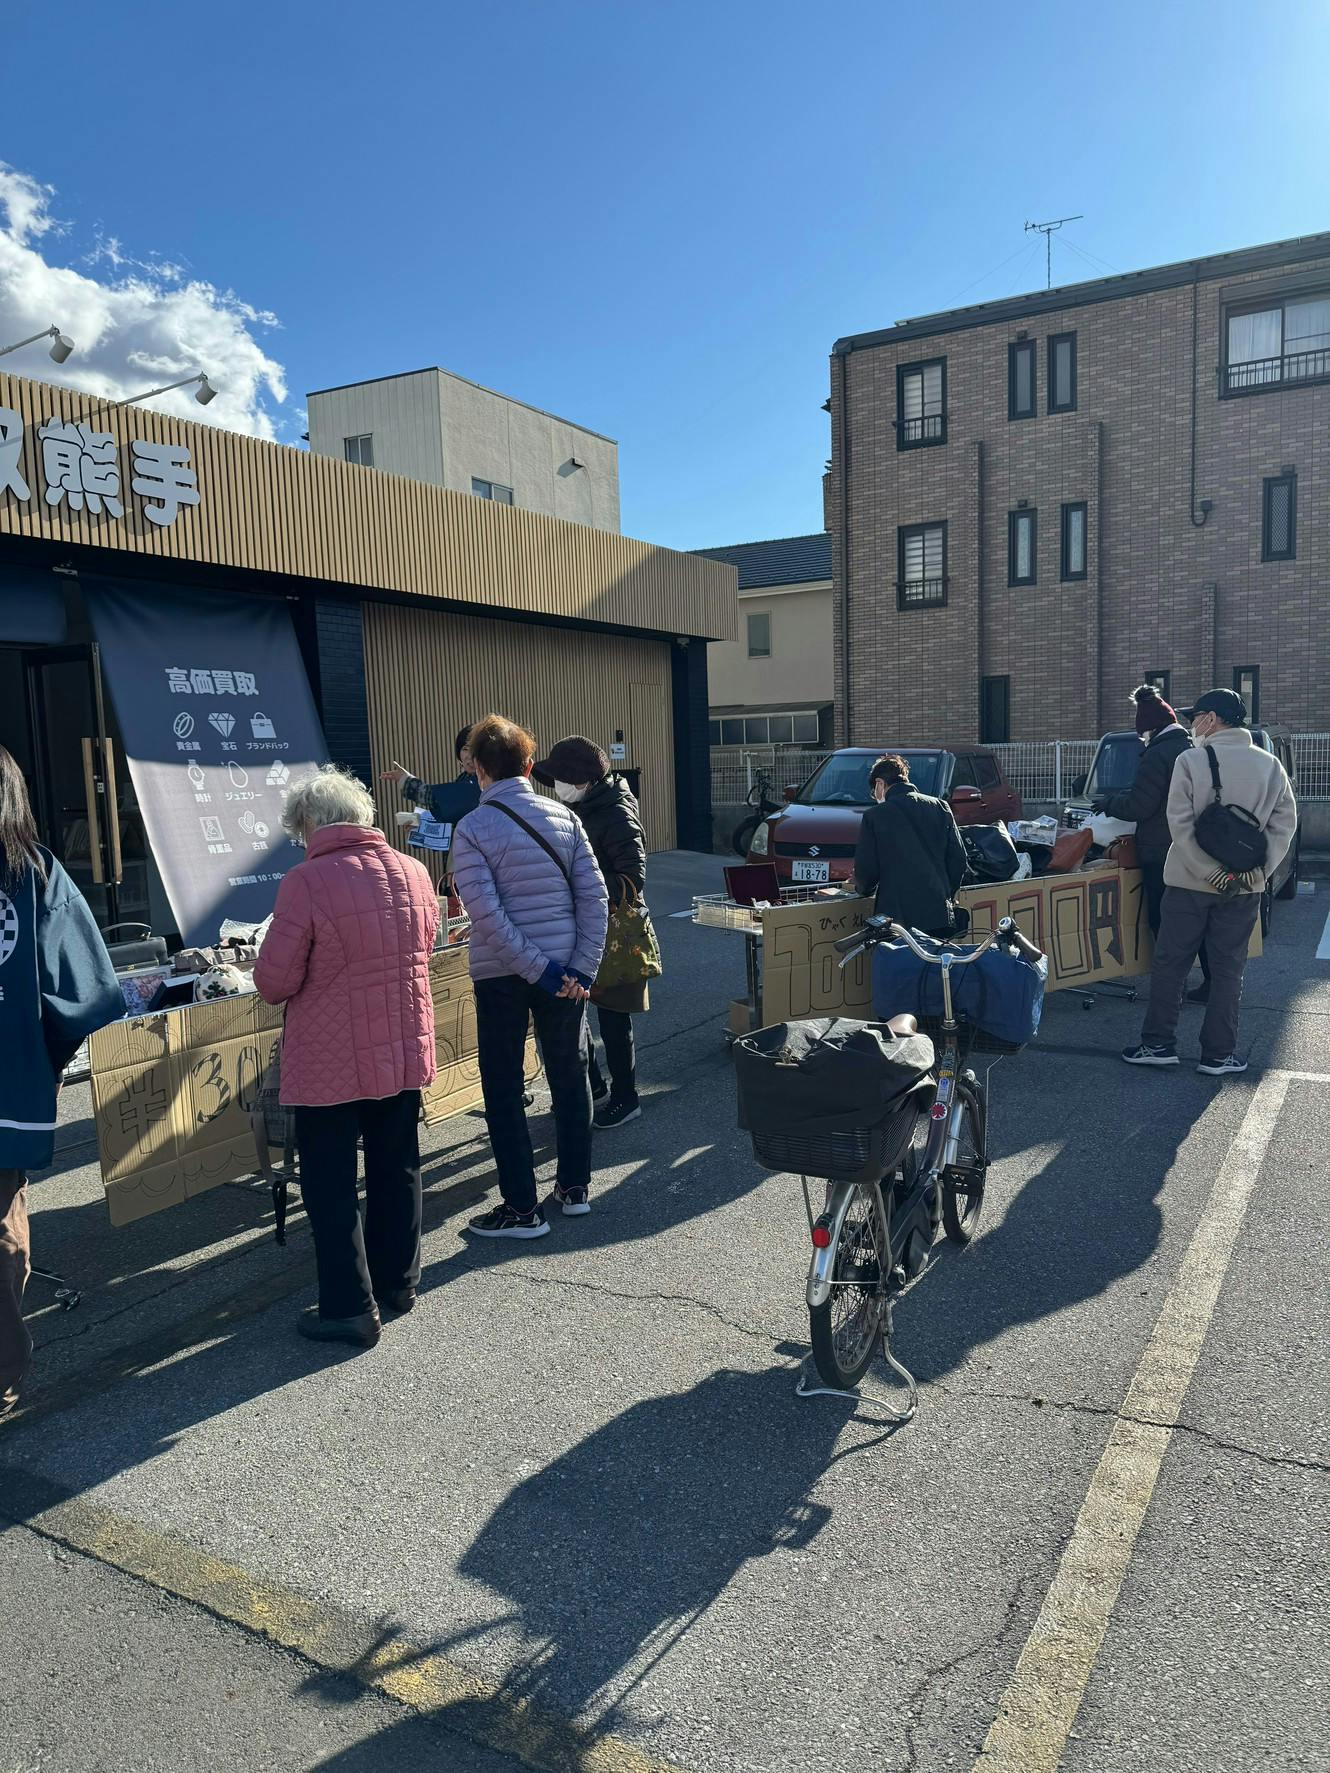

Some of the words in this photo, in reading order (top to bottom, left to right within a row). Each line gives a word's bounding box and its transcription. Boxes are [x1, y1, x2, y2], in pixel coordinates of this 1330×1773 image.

[165, 667, 259, 696] 高価買取
[220, 741, 238, 751] 宝石
[225, 791, 263, 801] ジュエリー
[801, 869, 827, 880] 18-78
